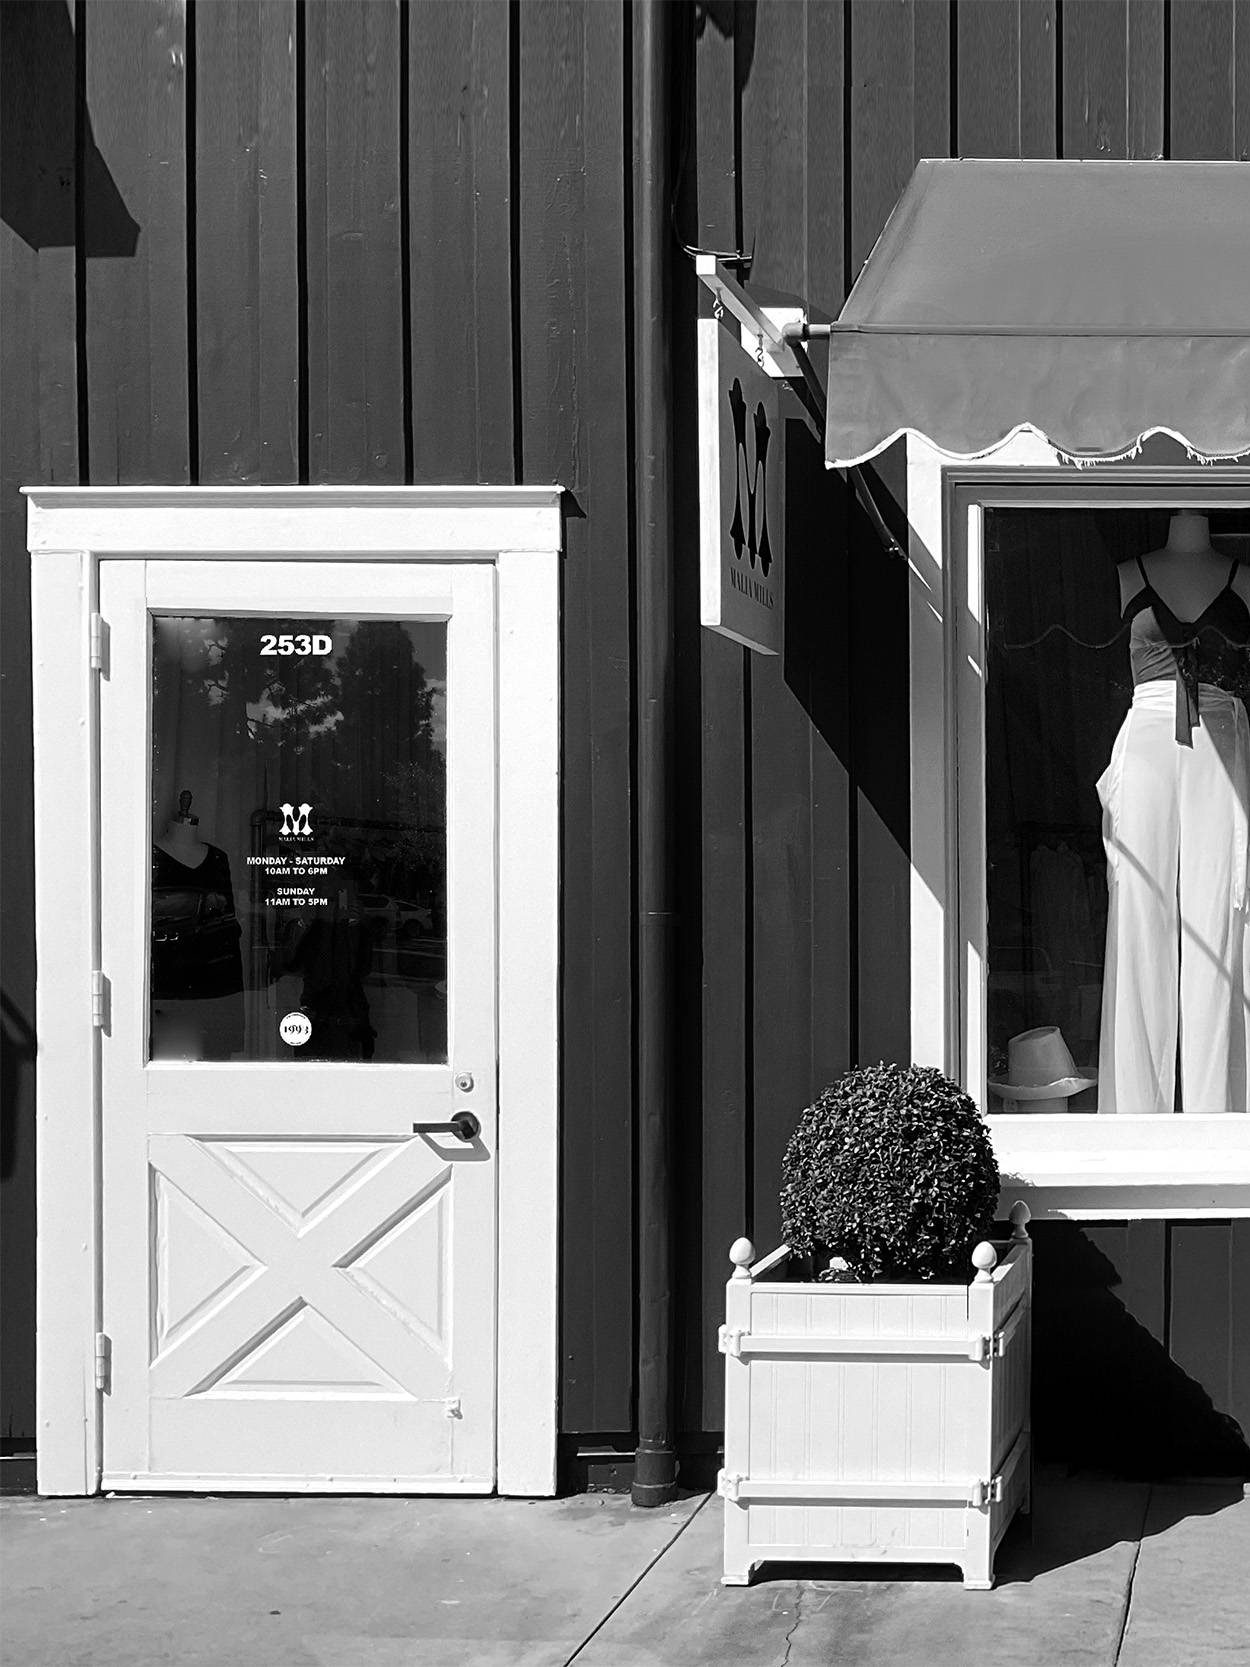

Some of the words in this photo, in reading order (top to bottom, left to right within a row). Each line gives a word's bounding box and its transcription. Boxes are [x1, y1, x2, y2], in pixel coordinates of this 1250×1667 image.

[259, 634, 333, 656] 253D
[246, 856, 288, 866] MONDAY
[295, 856, 346, 866] SATURDAY
[264, 867, 291, 875] 10AM
[292, 867, 306, 875] TO
[307, 867, 328, 875] 6PM
[276, 887, 316, 896] SUNDAY
[264, 898, 291, 906] 11AM
[292, 898, 306, 906] TO
[307, 898, 328, 906] 5PM
[284, 1024, 309, 1035] 1993
